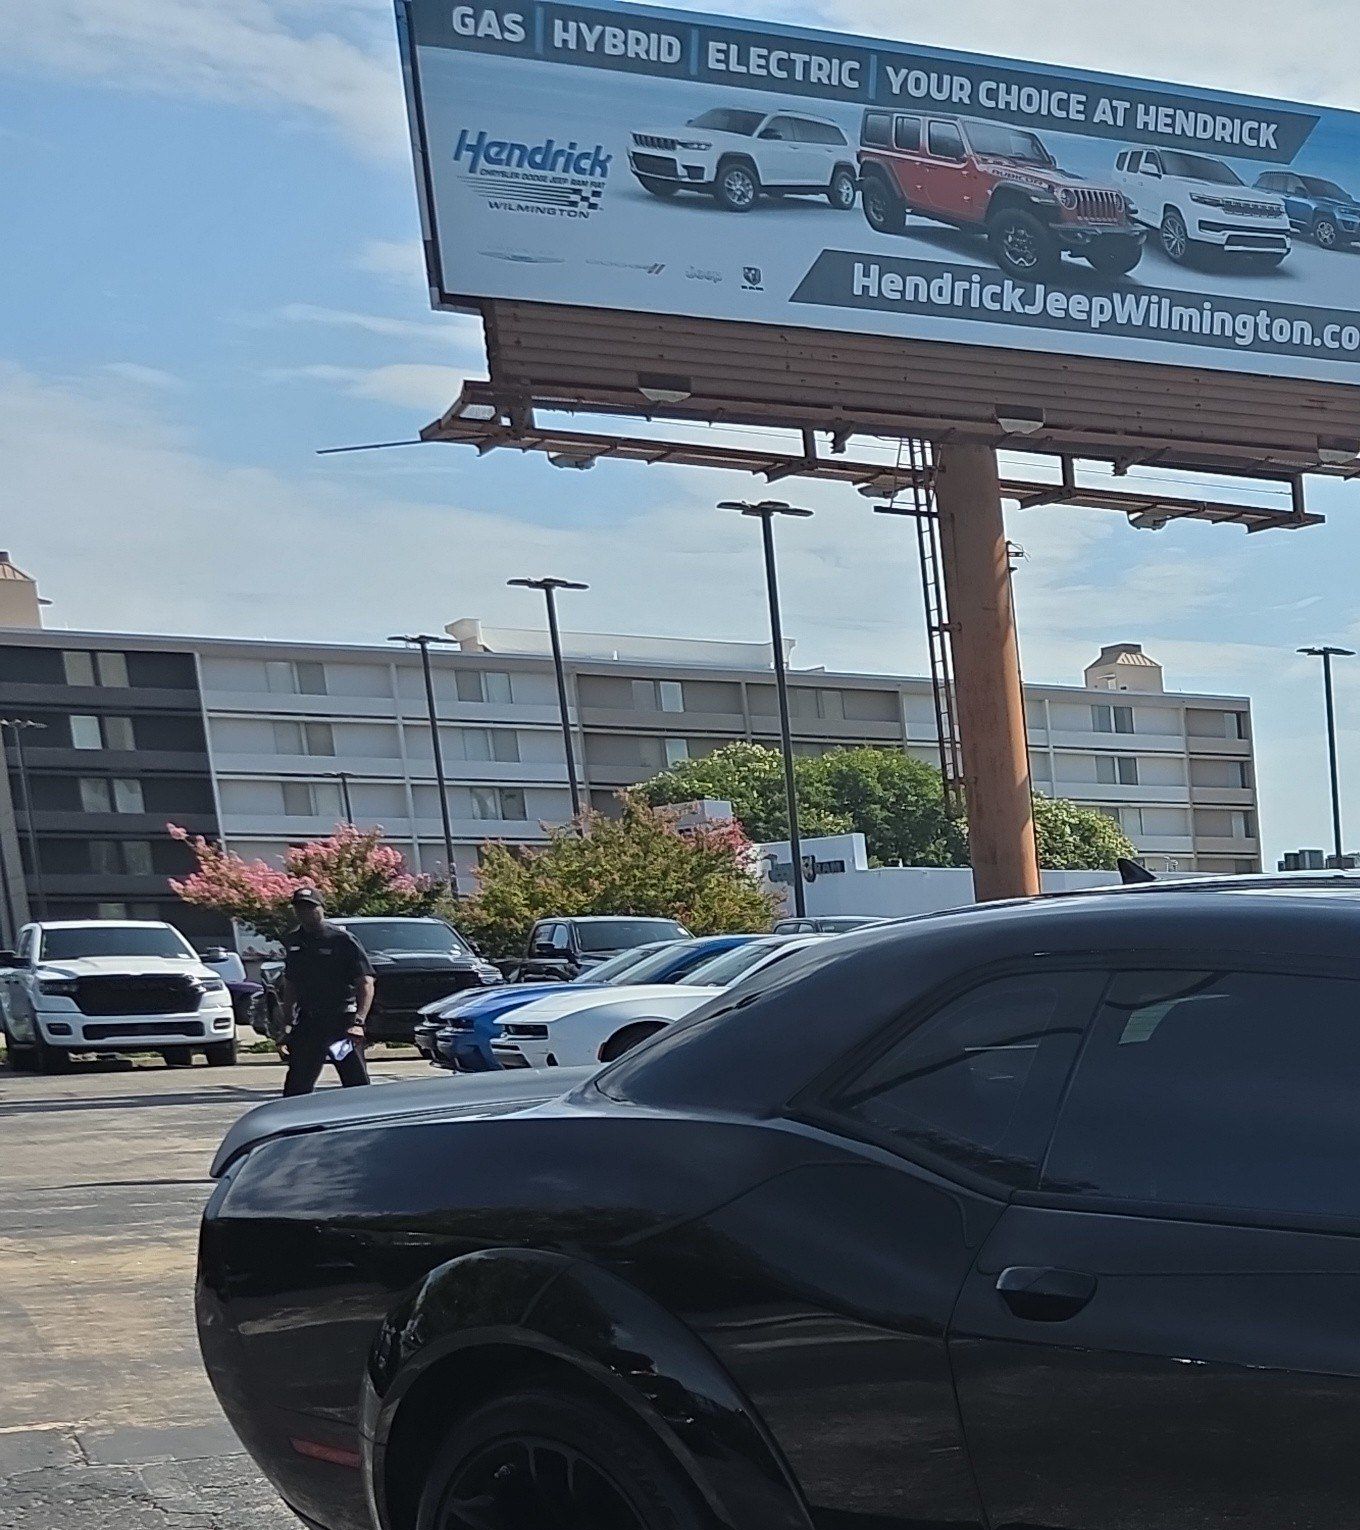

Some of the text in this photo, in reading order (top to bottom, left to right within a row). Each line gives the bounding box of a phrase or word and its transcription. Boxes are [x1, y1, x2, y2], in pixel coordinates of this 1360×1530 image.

[452, 5, 1278, 150] GAS HYBRID ELECTRIC YOUR CHOICE AT HENDRICK
[453, 129, 613, 178] Hendrick
[488, 200, 590, 219] WILMINGTON
